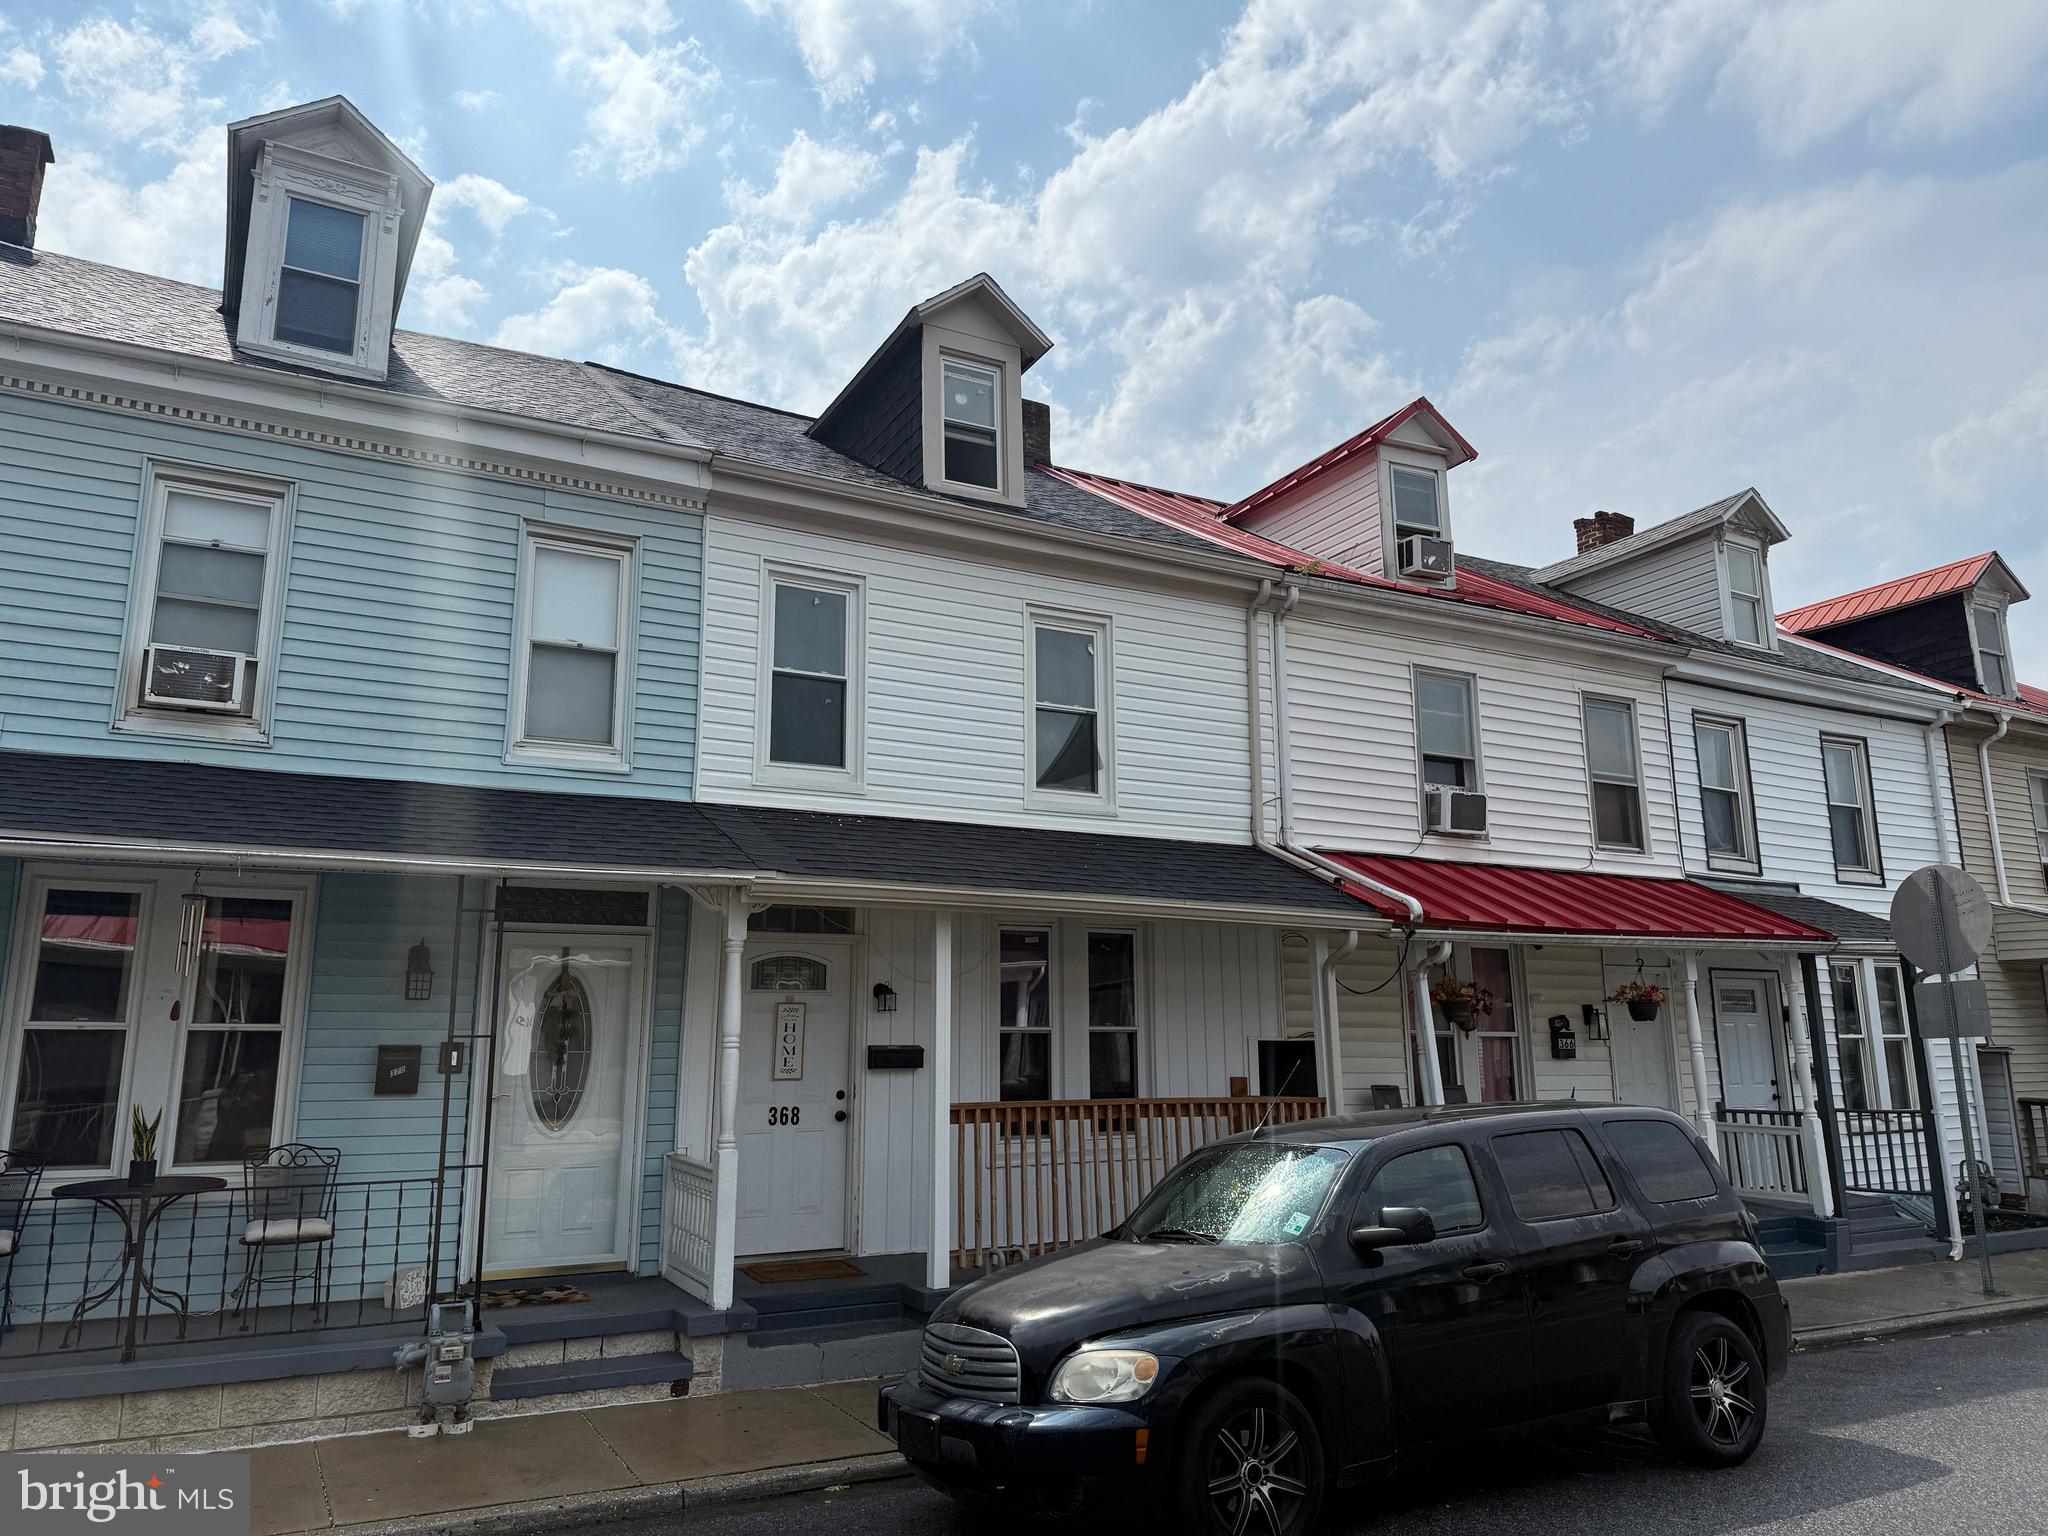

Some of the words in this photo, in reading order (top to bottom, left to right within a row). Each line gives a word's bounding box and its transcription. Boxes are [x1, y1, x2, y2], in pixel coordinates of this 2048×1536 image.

[782, 1022, 797, 1067] HOME
[1559, 1039, 1574, 1049] 366
[768, 1106, 800, 1126] 368
